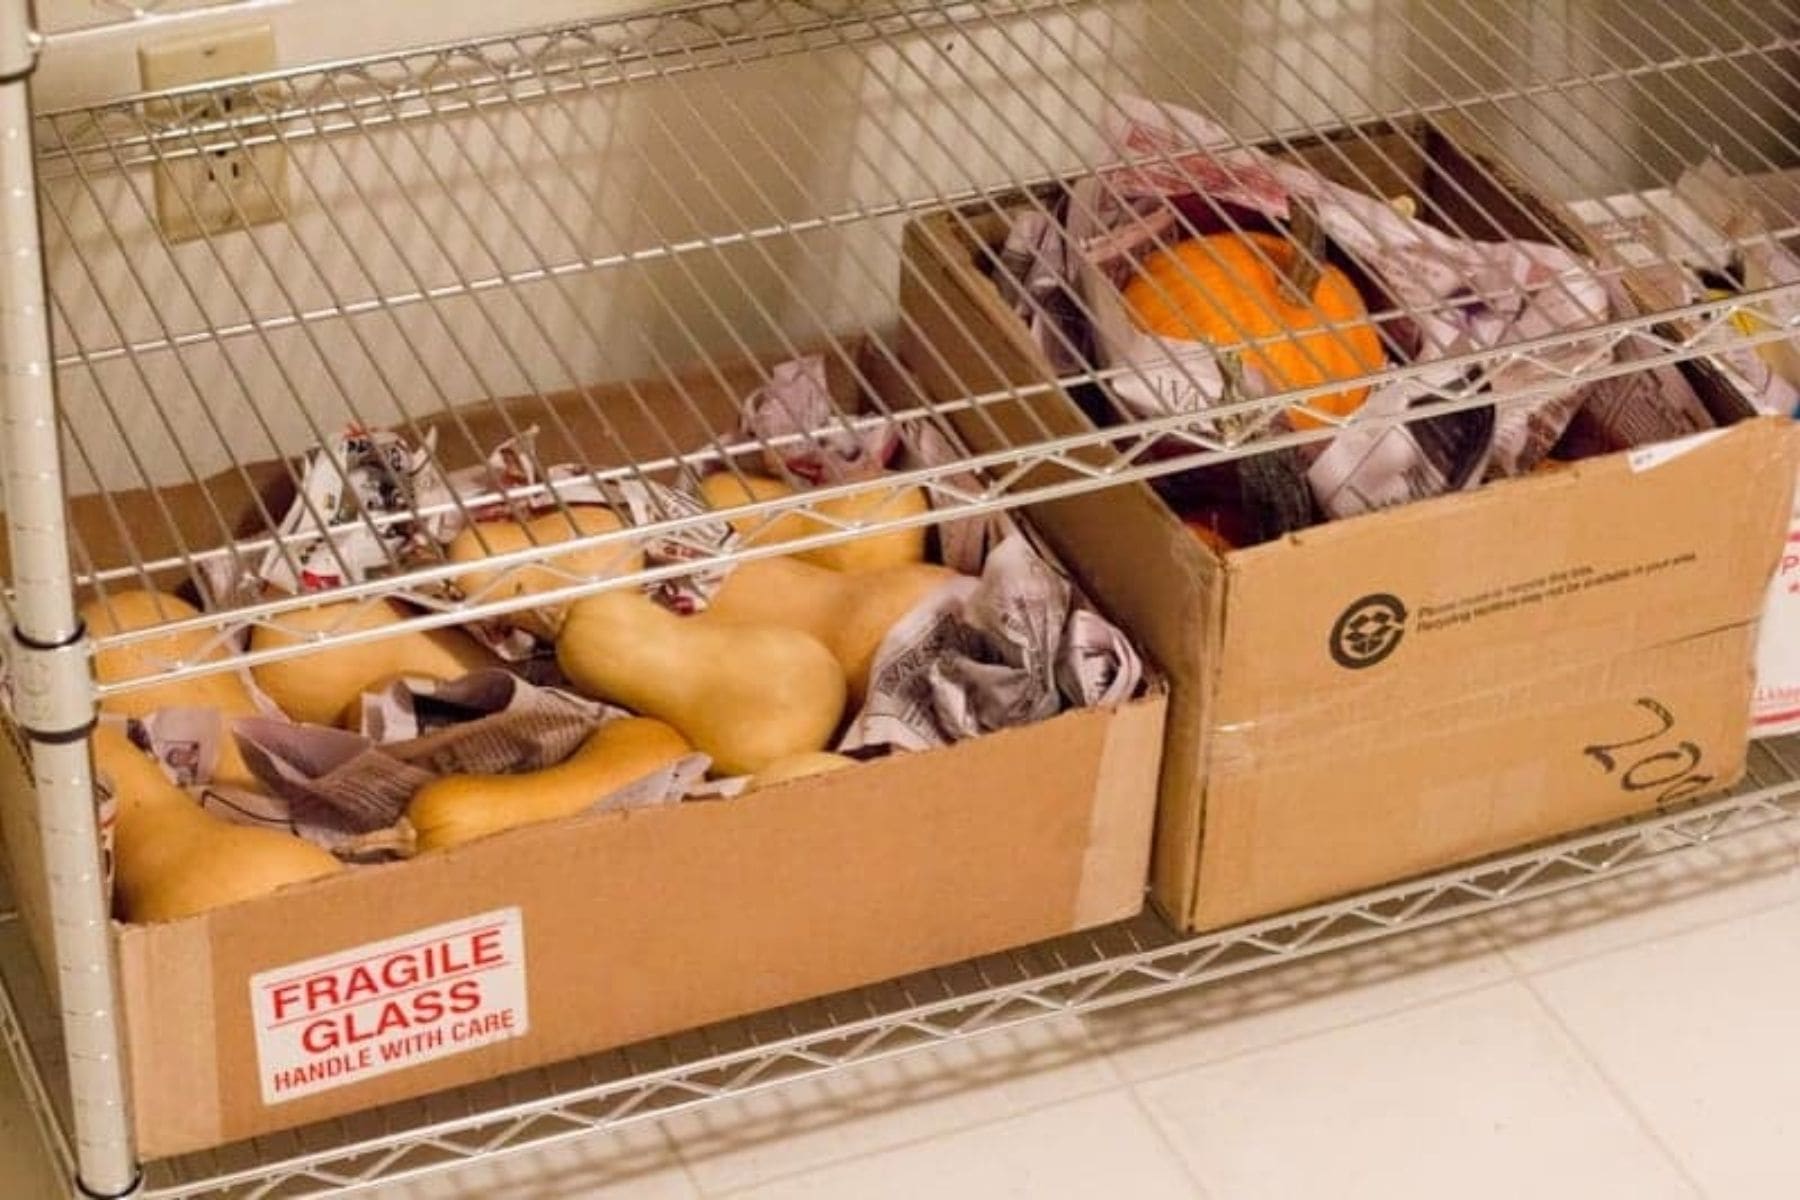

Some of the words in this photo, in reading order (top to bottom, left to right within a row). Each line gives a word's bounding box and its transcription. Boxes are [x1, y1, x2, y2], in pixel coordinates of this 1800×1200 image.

[272, 929, 503, 1019] FRAGILE
[274, 1049, 371, 1092] HANDLE
[380, 1029, 442, 1062] WITH
[451, 1008, 514, 1042] CARE
[302, 980, 481, 1053] GLASS
